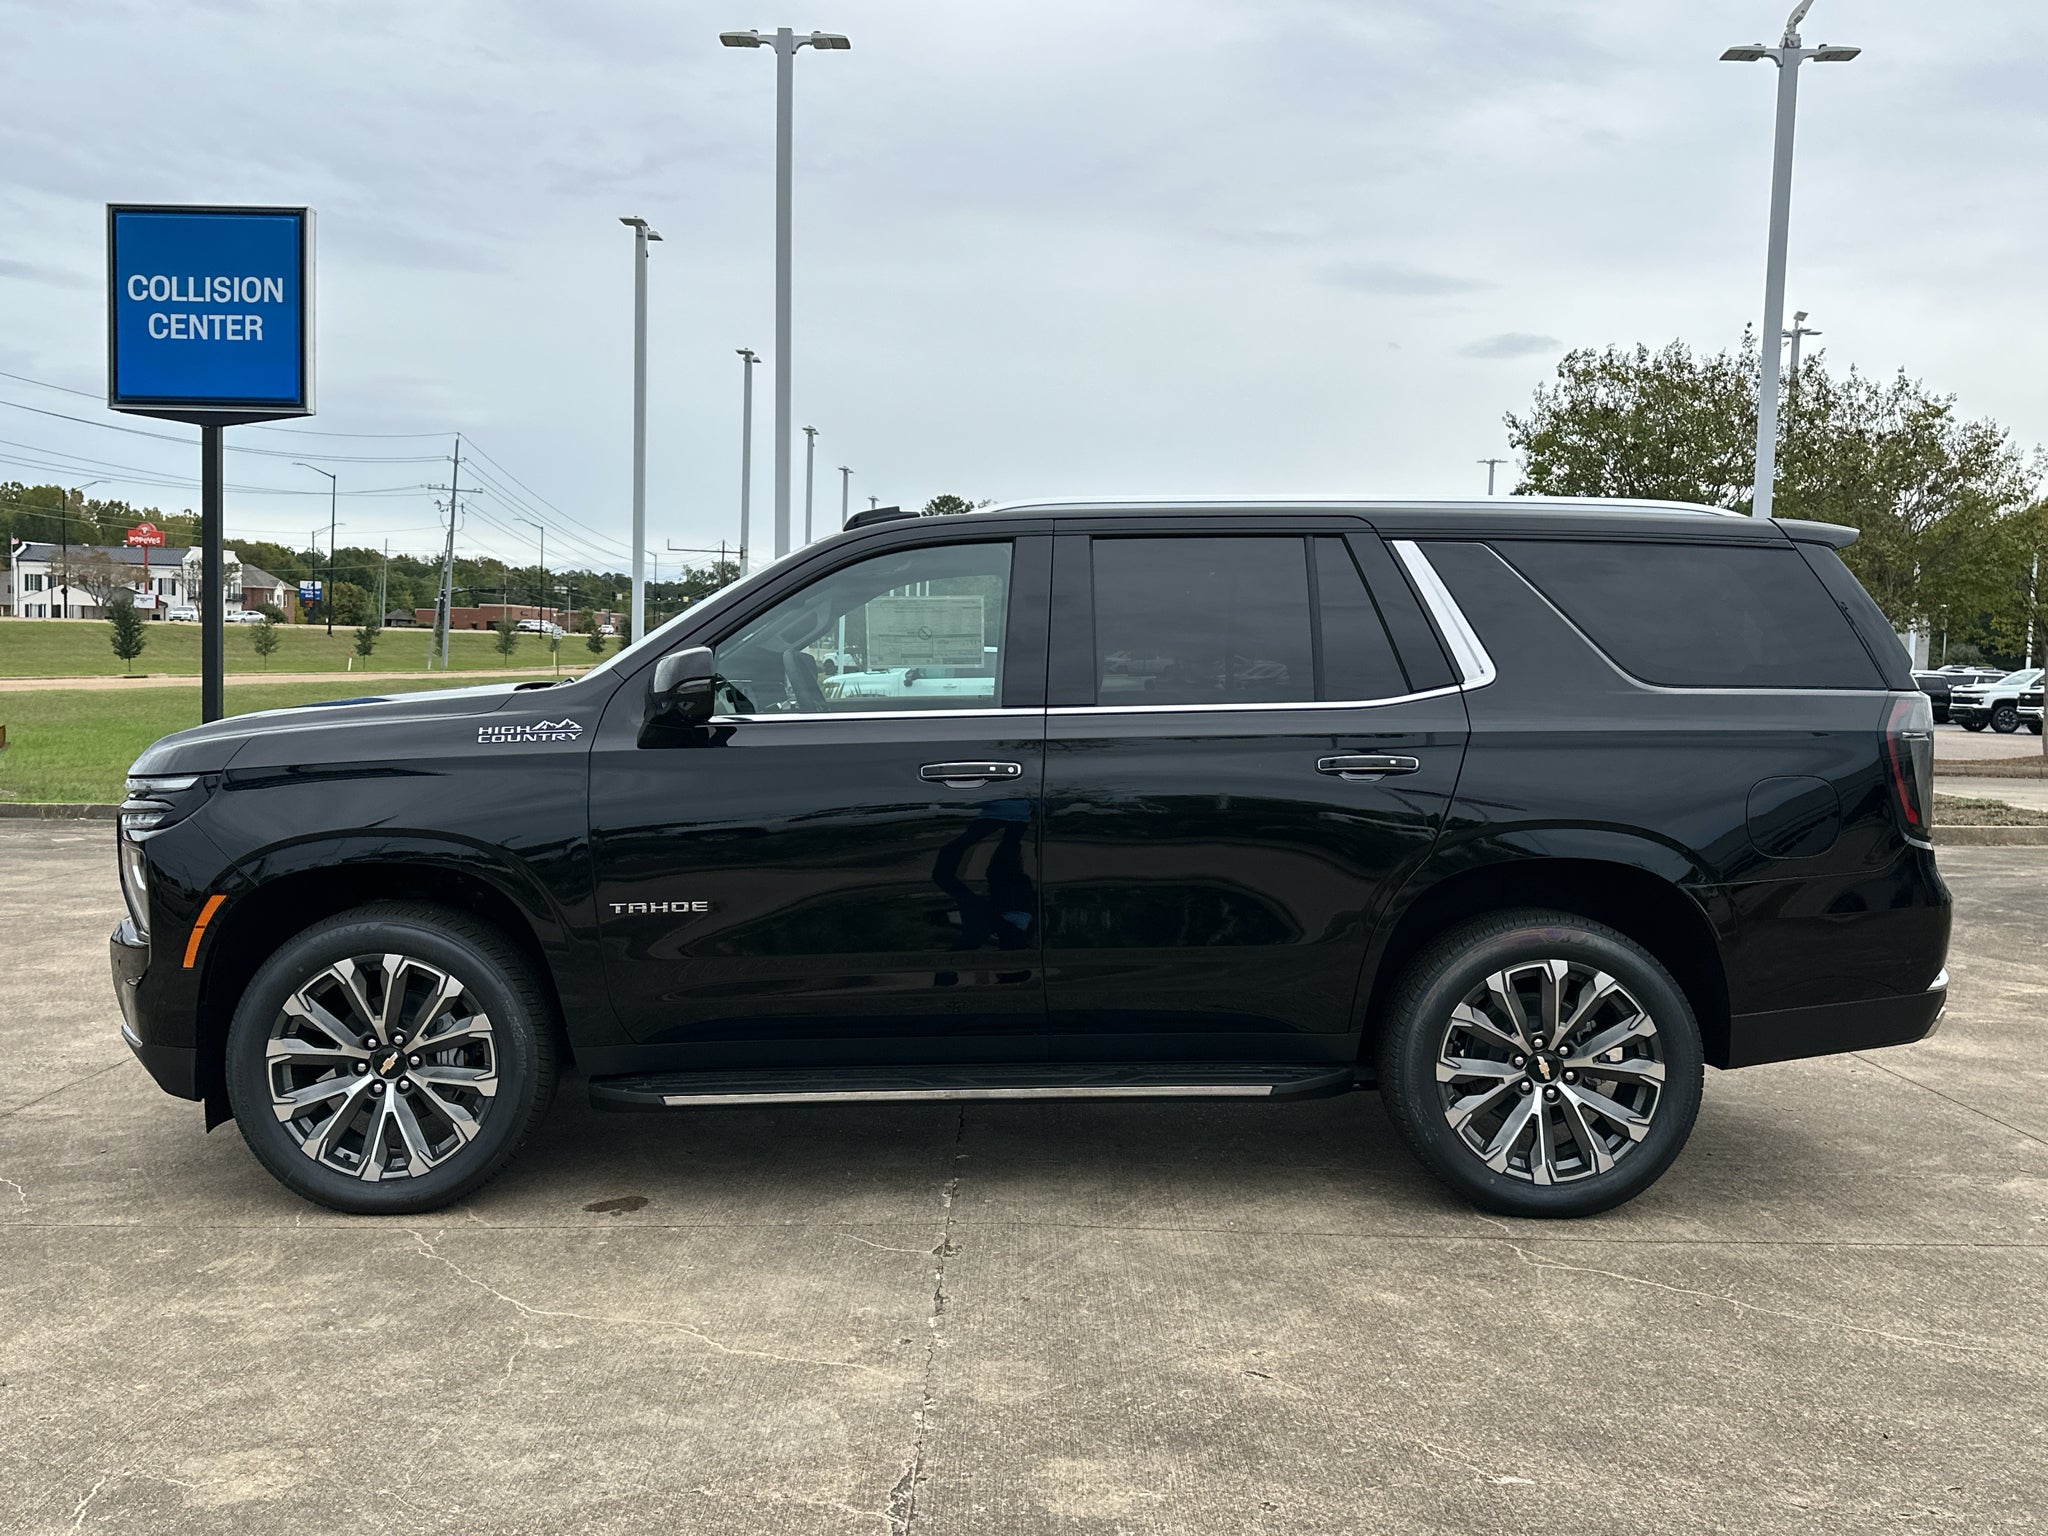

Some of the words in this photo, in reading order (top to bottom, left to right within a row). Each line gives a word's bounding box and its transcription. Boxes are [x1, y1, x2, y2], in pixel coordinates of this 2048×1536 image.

[127, 274, 283, 303] COLLISION
[148, 312, 263, 341] CENTER
[478, 725, 530, 735] HIGH
[477, 732, 582, 743] COUNTRY
[609, 901, 709, 914] TAHOE
